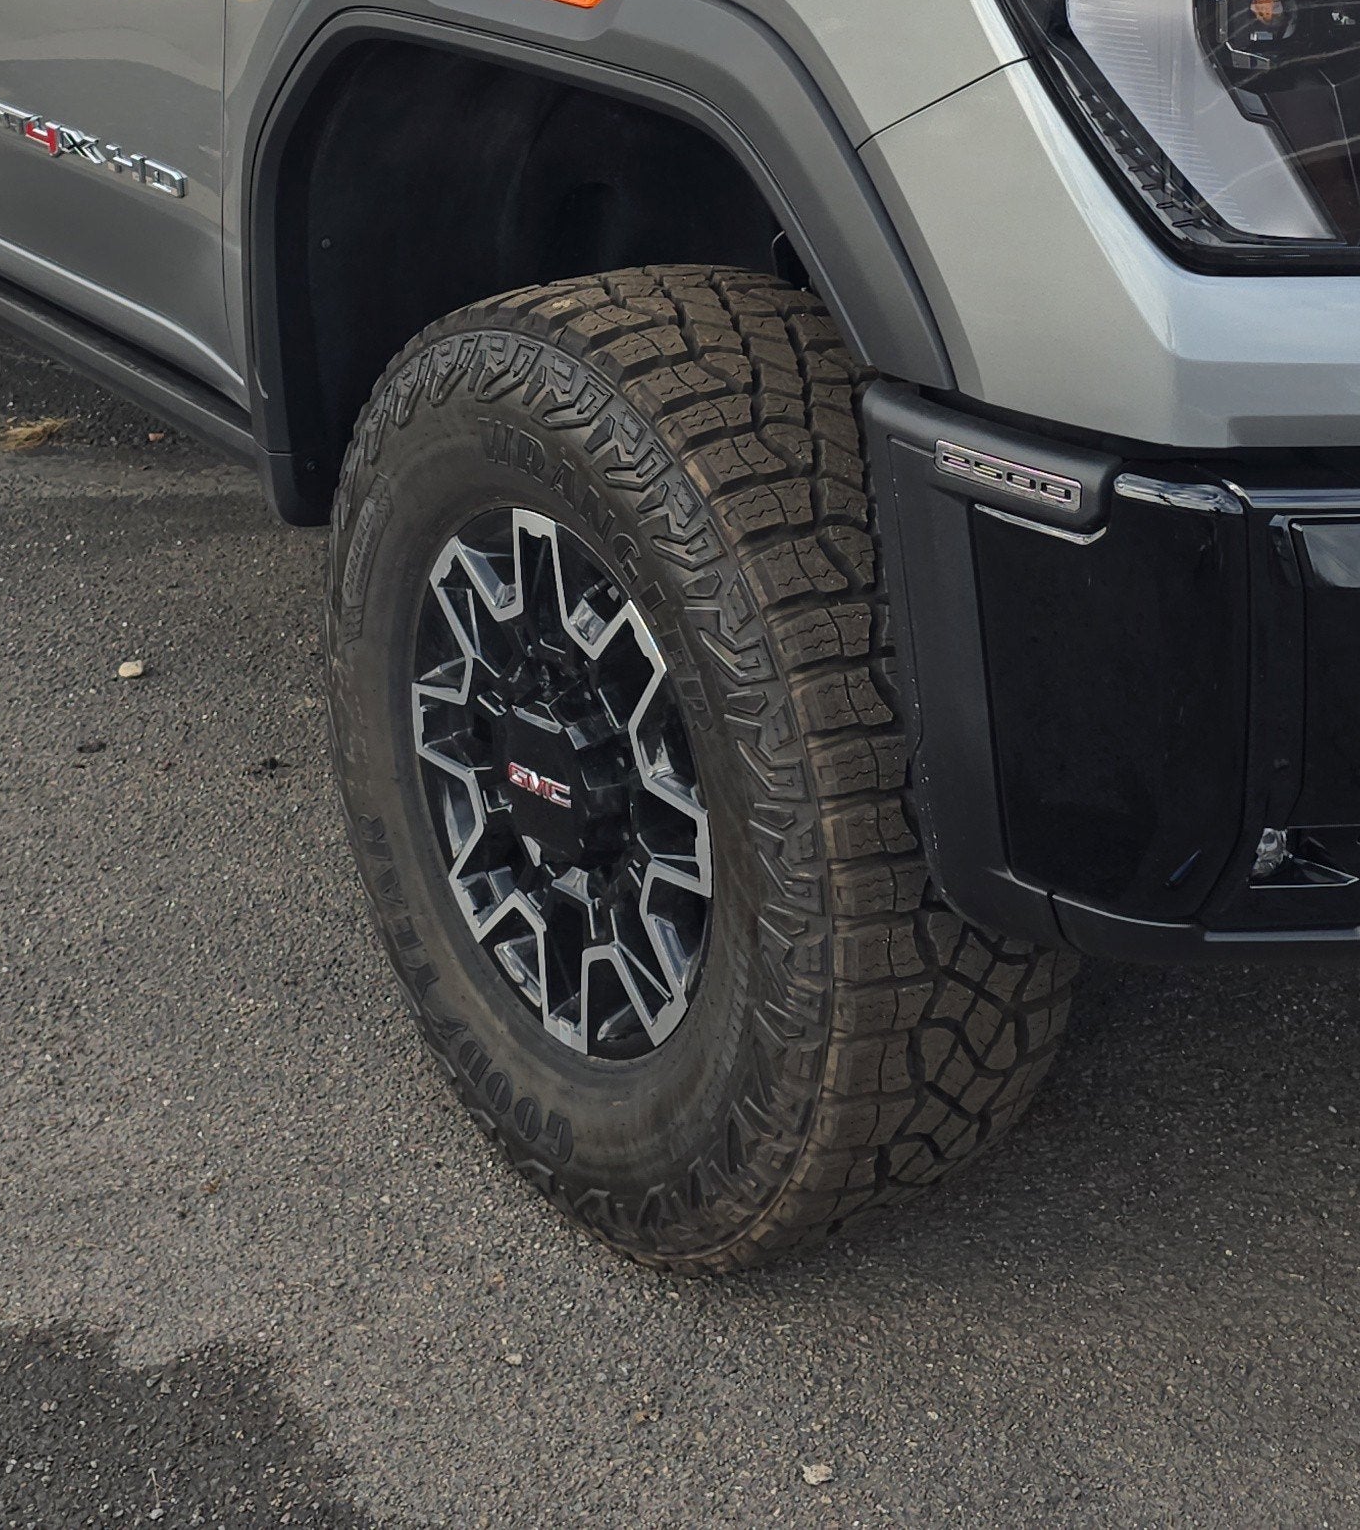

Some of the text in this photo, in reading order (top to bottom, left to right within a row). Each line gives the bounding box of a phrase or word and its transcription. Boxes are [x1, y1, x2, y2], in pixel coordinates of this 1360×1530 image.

[105, 144, 189, 198] HD
[941, 451, 1073, 503] 2500
[508, 761, 572, 808] GMC
